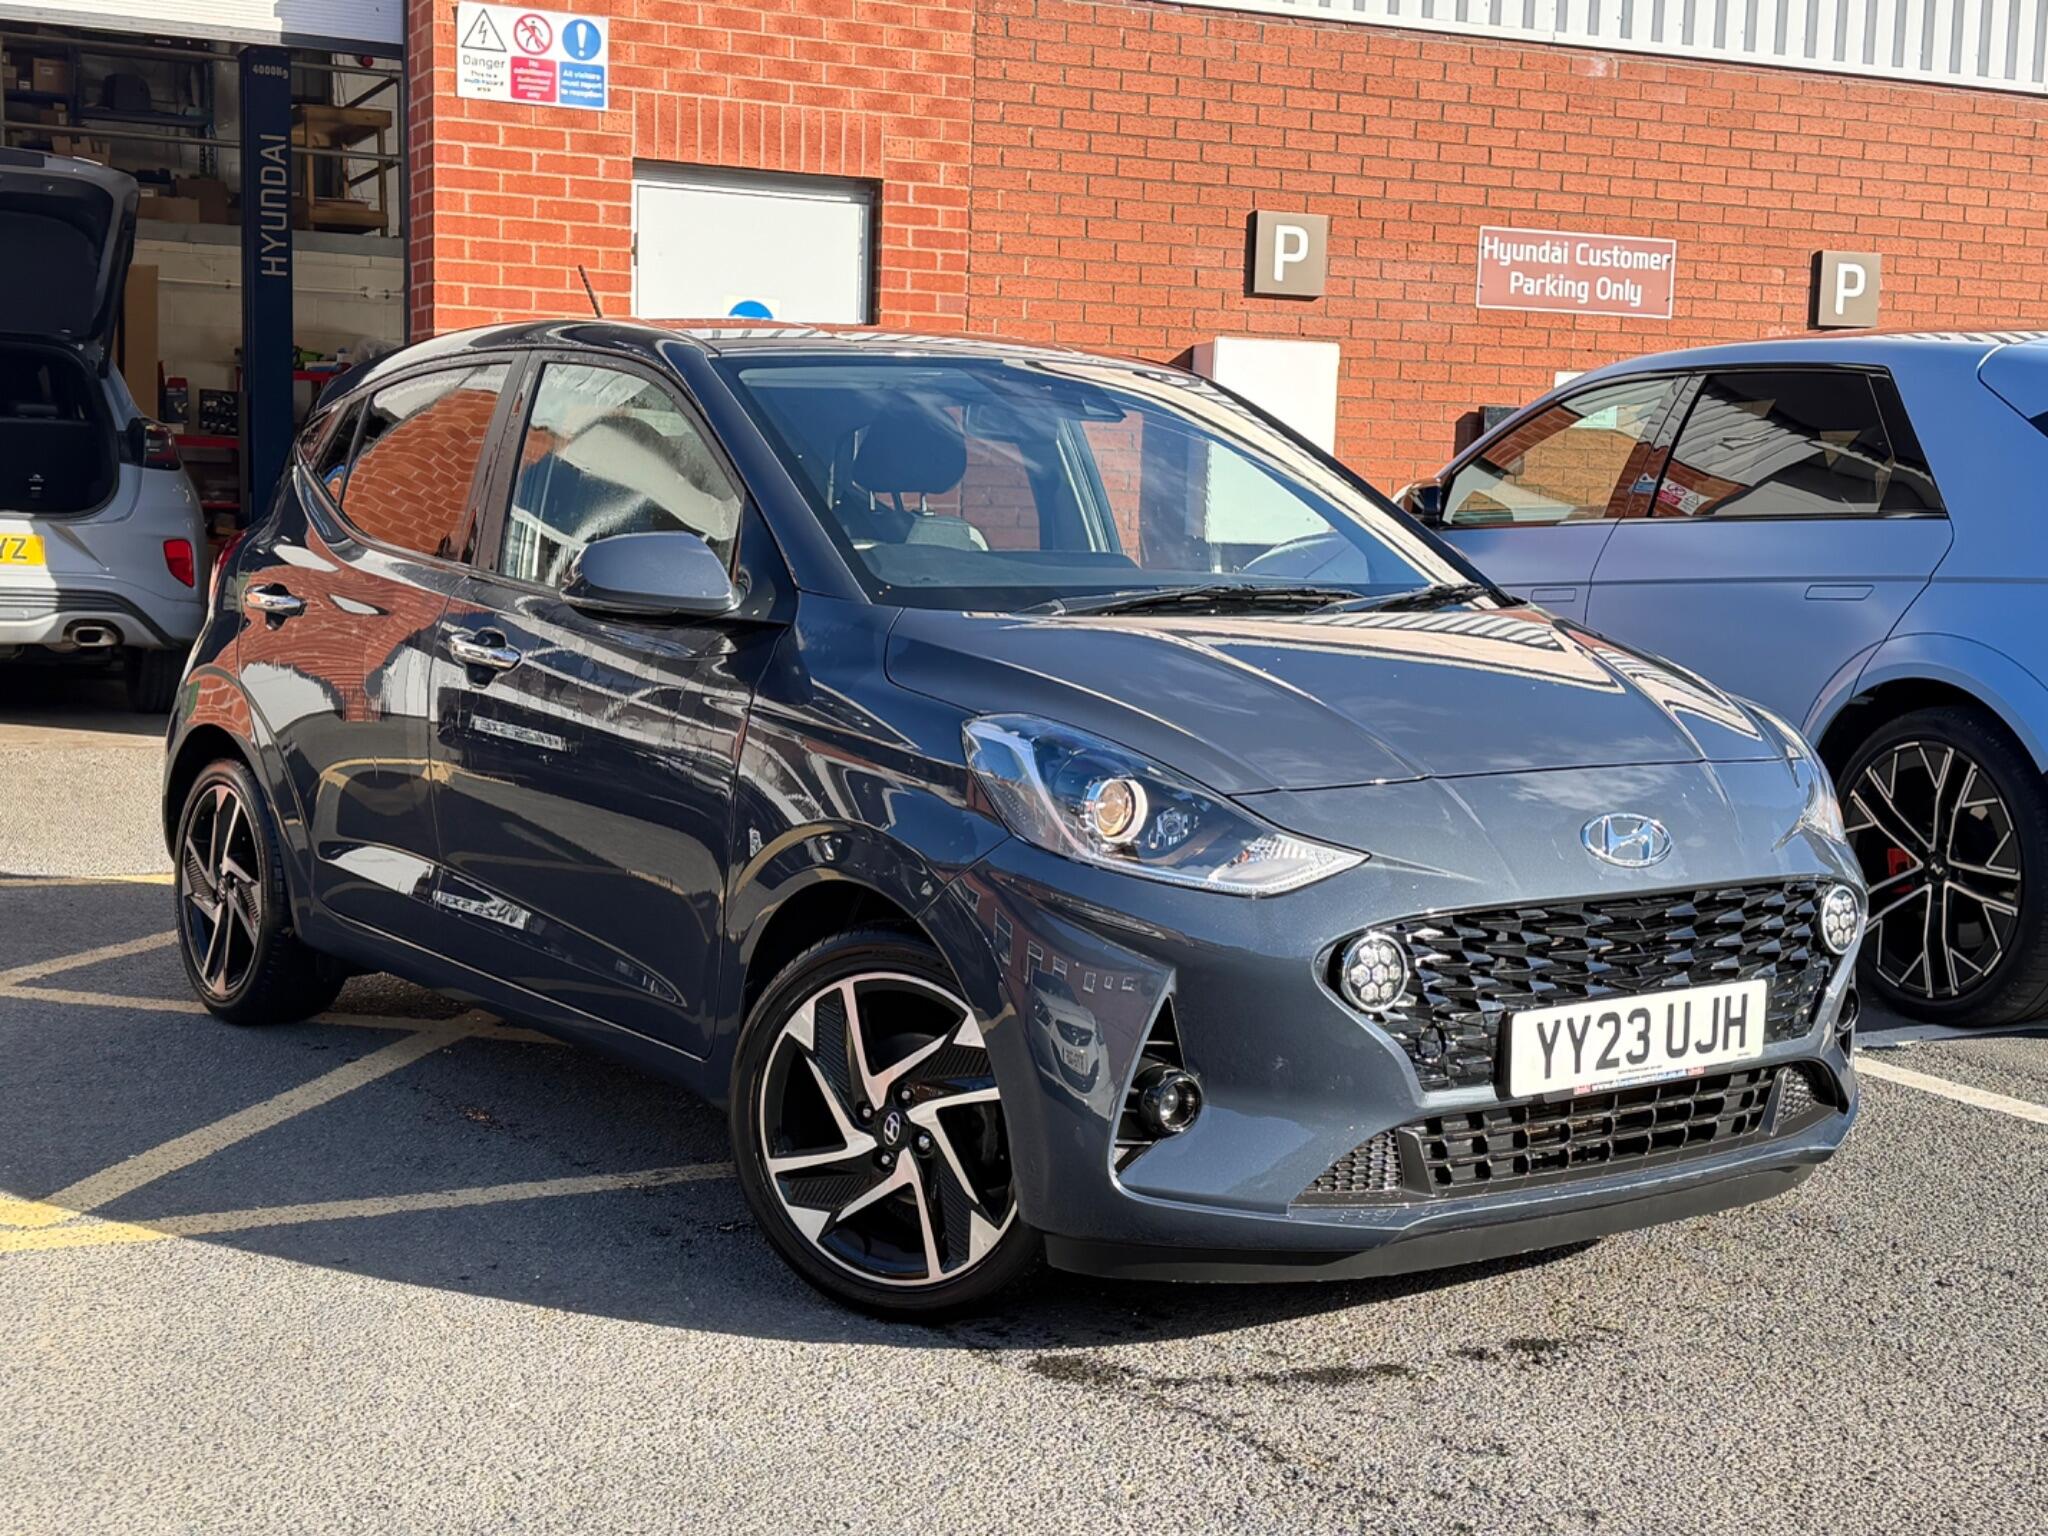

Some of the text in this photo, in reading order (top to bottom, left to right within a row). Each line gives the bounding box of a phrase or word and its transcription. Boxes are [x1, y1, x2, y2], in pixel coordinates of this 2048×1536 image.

[462, 54, 505, 70] Danger
[259, 134, 287, 276] HYUNDAI
[1273, 224, 1309, 282] P
[1482, 235, 1671, 272] Hyundai Customer
[1509, 271, 1642, 307] Parking Only
[1833, 262, 1866, 315] P
[1536, 993, 1748, 1079] YY23 UJH
